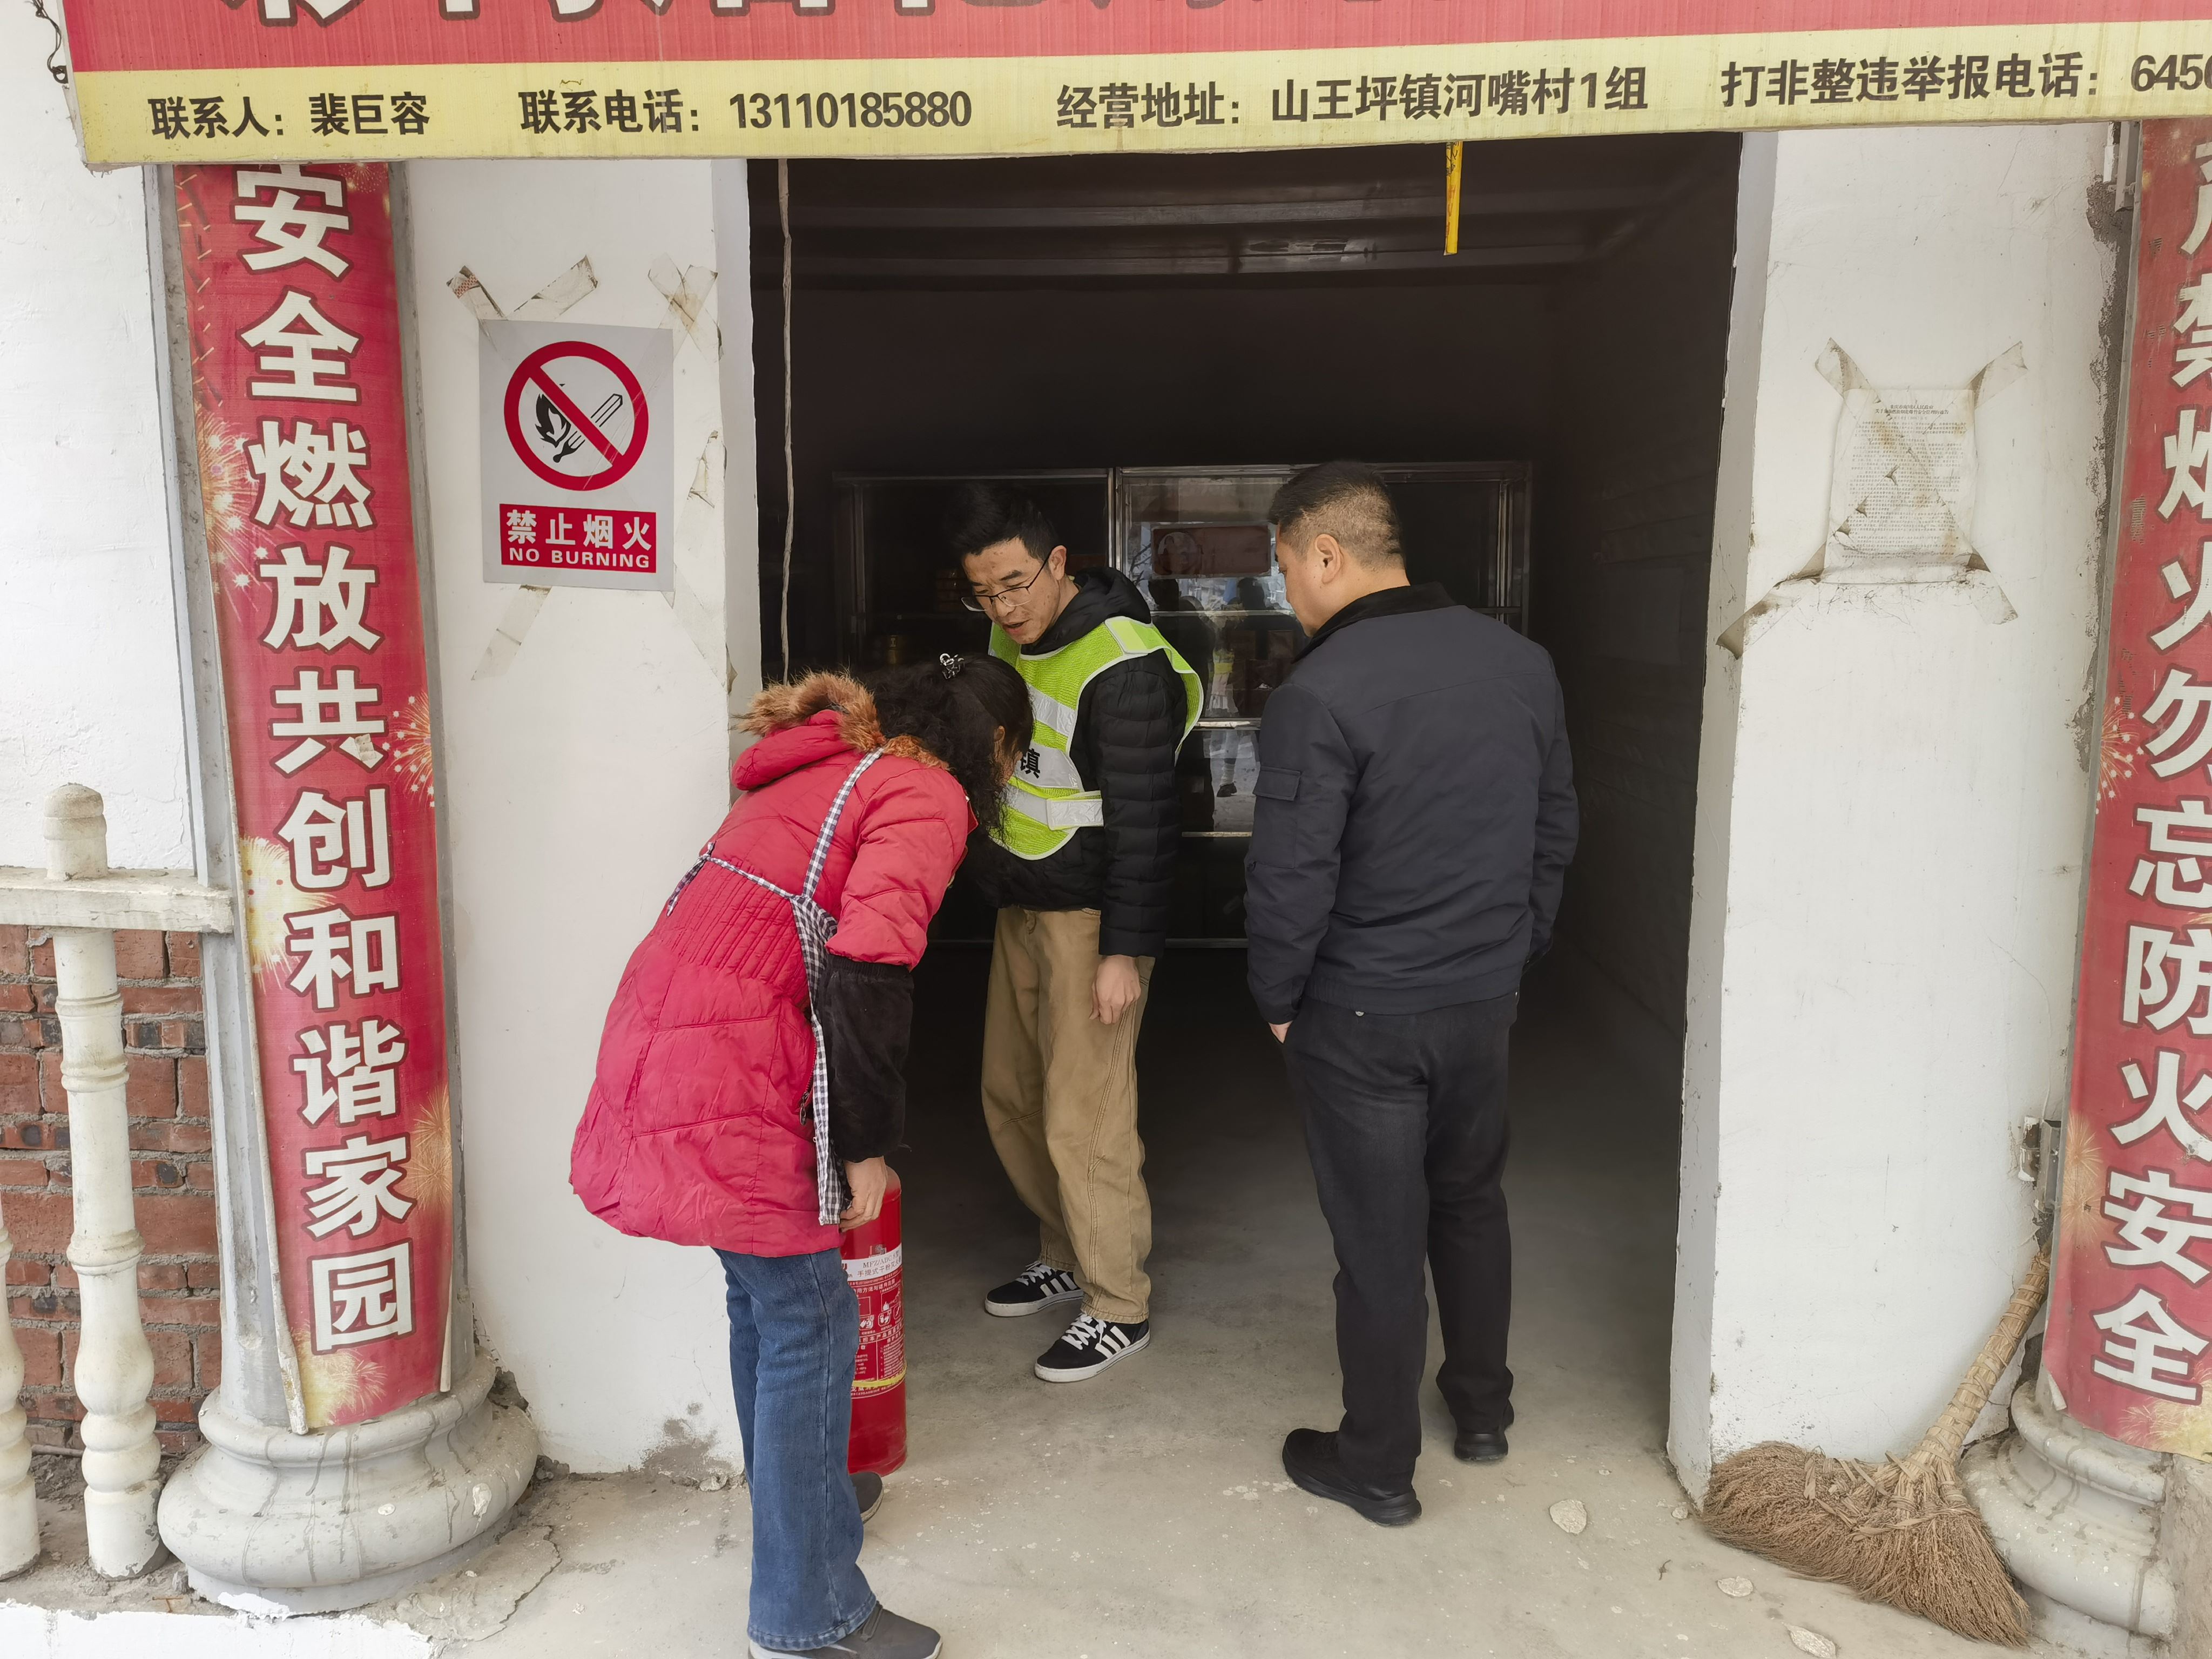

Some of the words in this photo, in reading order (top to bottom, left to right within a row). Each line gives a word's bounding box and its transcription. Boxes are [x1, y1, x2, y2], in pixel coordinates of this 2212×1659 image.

[506, 509, 652, 551] 禁止烟火
[509, 548, 539, 562] NO
[551, 550, 650, 568] BURNING
[234, 164, 413, 1352] 安全燃放共创和谐家园
